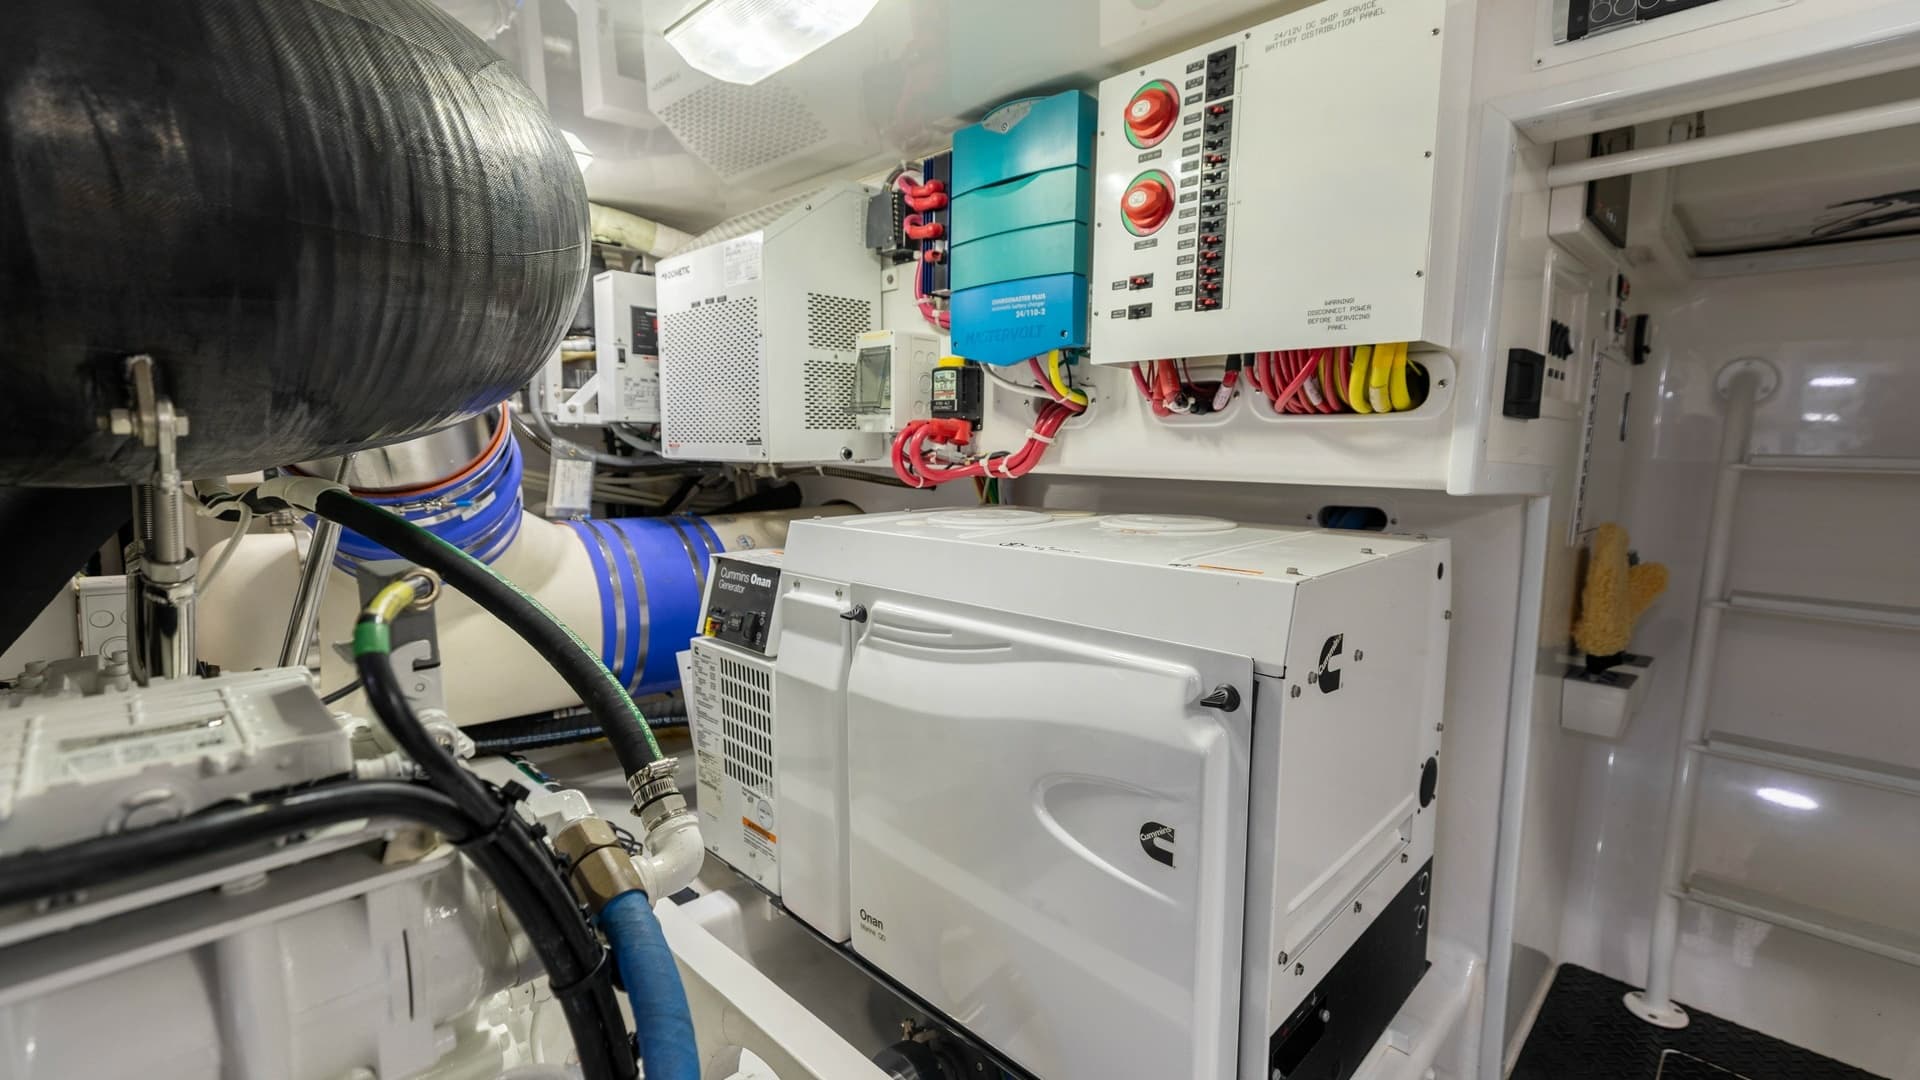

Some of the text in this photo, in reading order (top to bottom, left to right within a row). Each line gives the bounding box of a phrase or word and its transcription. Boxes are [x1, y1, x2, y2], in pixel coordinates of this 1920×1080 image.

[1305, 20, 1317, 30] DC
[1320, 13, 1339, 26] SHIP
[1343, 0, 1377, 17] SERVICE
[1265, 7, 1386, 54] BATTERY DISTRIBUTION PANEL
[1308, 304, 1372, 317] DISCONNECT POWER
[1308, 313, 1370, 325] BEFORE SERVICING
[1328, 323, 1347, 331] PANEL
[720, 566, 772, 589] Cummins Onan
[718, 579, 746, 594] Generator
[1140, 827, 1173, 841] Cummins
[860, 908, 884, 930] Onan
